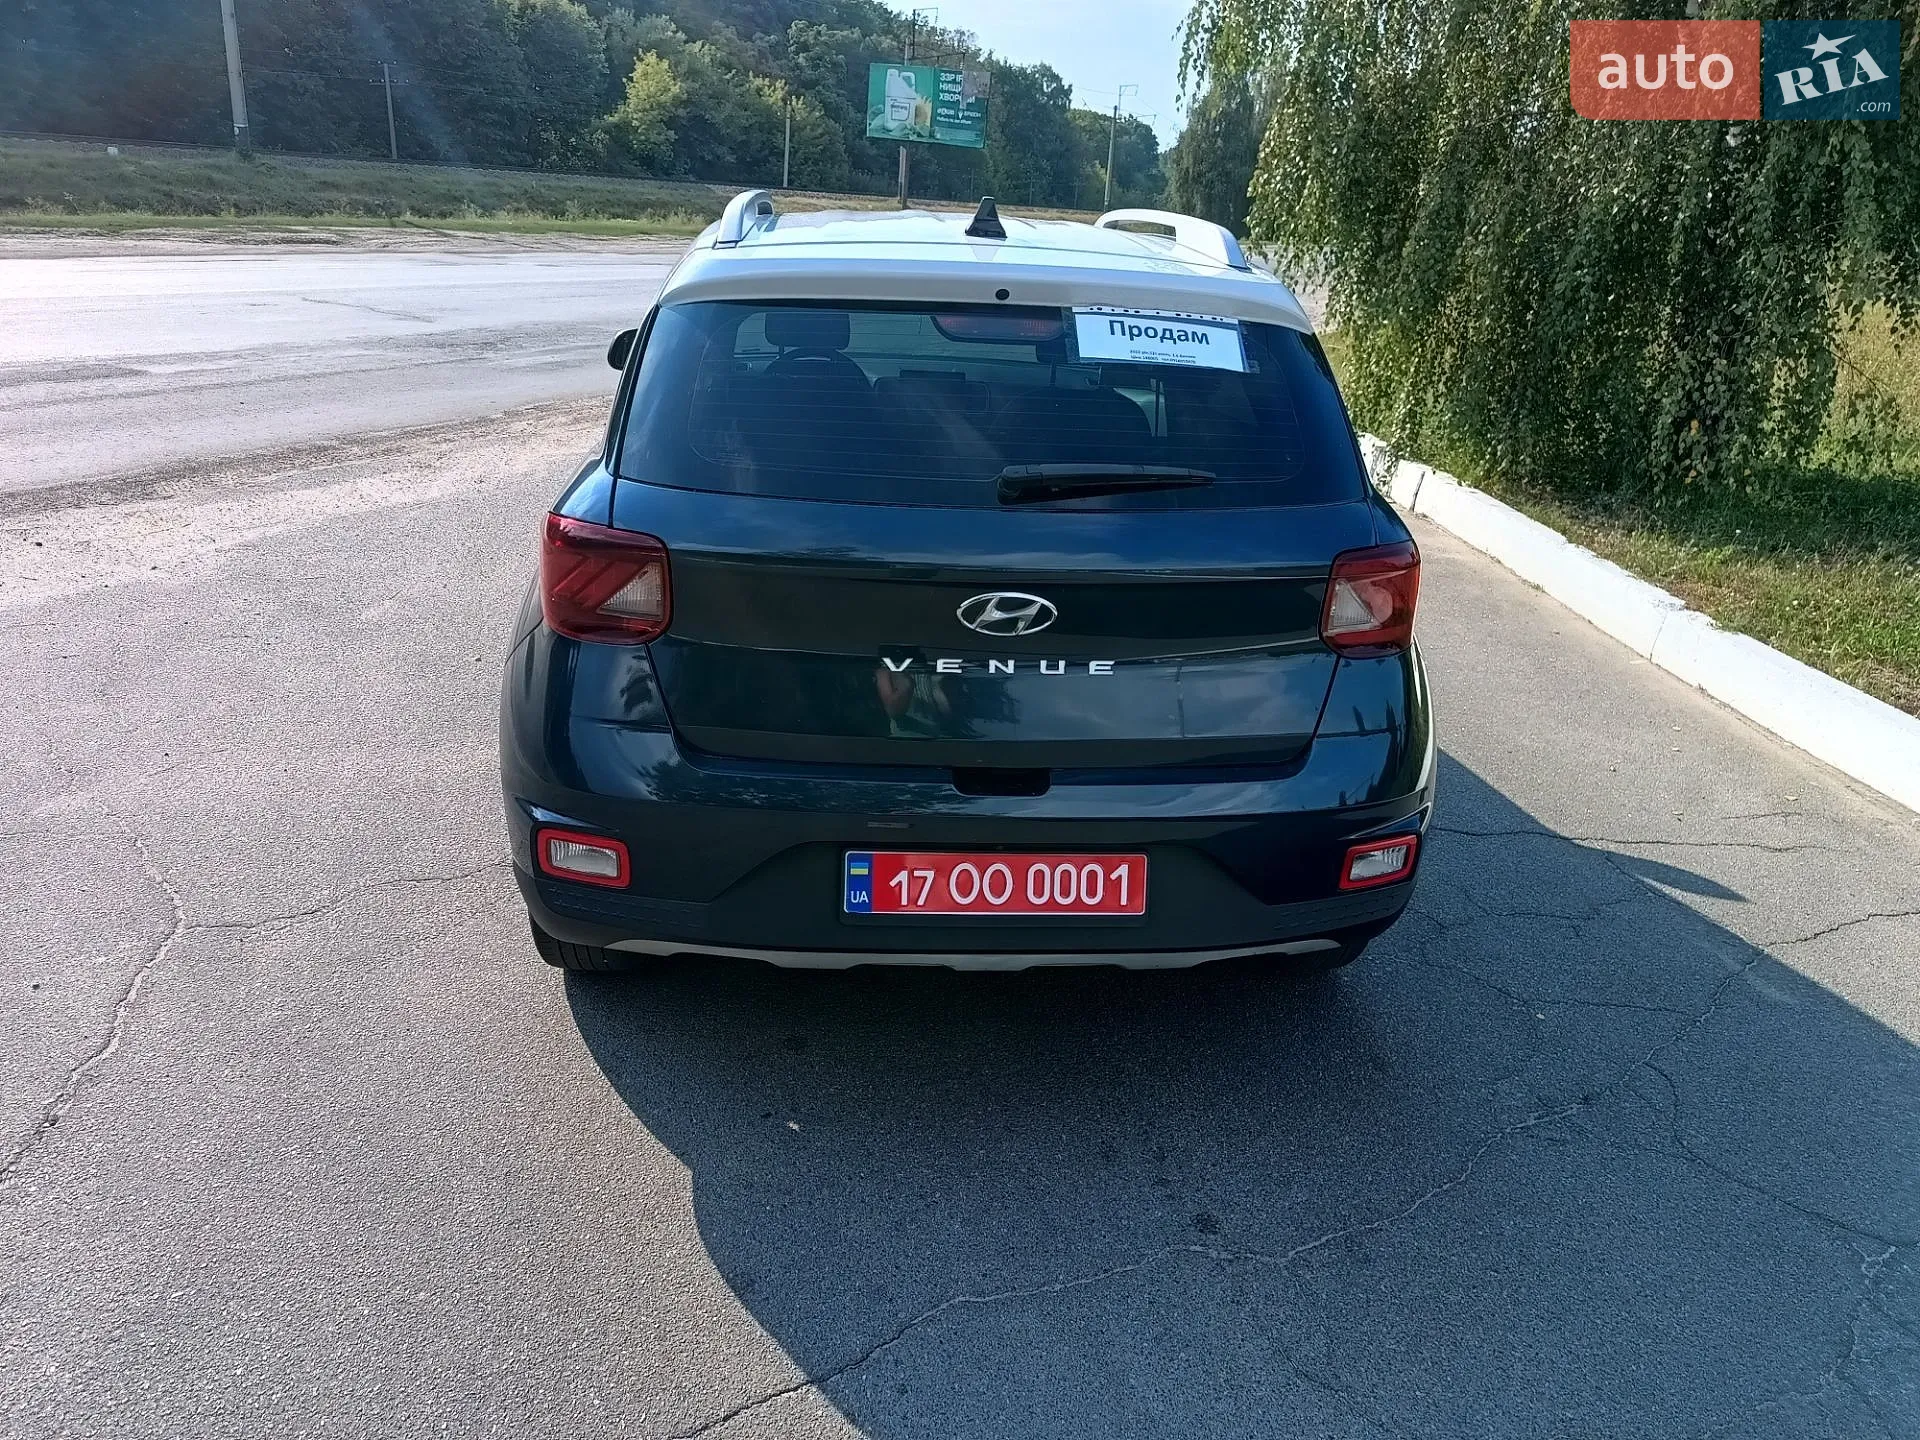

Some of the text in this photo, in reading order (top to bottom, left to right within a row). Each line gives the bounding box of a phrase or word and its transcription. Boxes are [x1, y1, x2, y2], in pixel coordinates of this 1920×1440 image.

[1108, 319, 1210, 346] Продам
[882, 657, 1116, 676] VENUE
[889, 870, 935, 906] 17
[1027, 863, 1130, 906] 0001
[850, 890, 869, 904] UA
